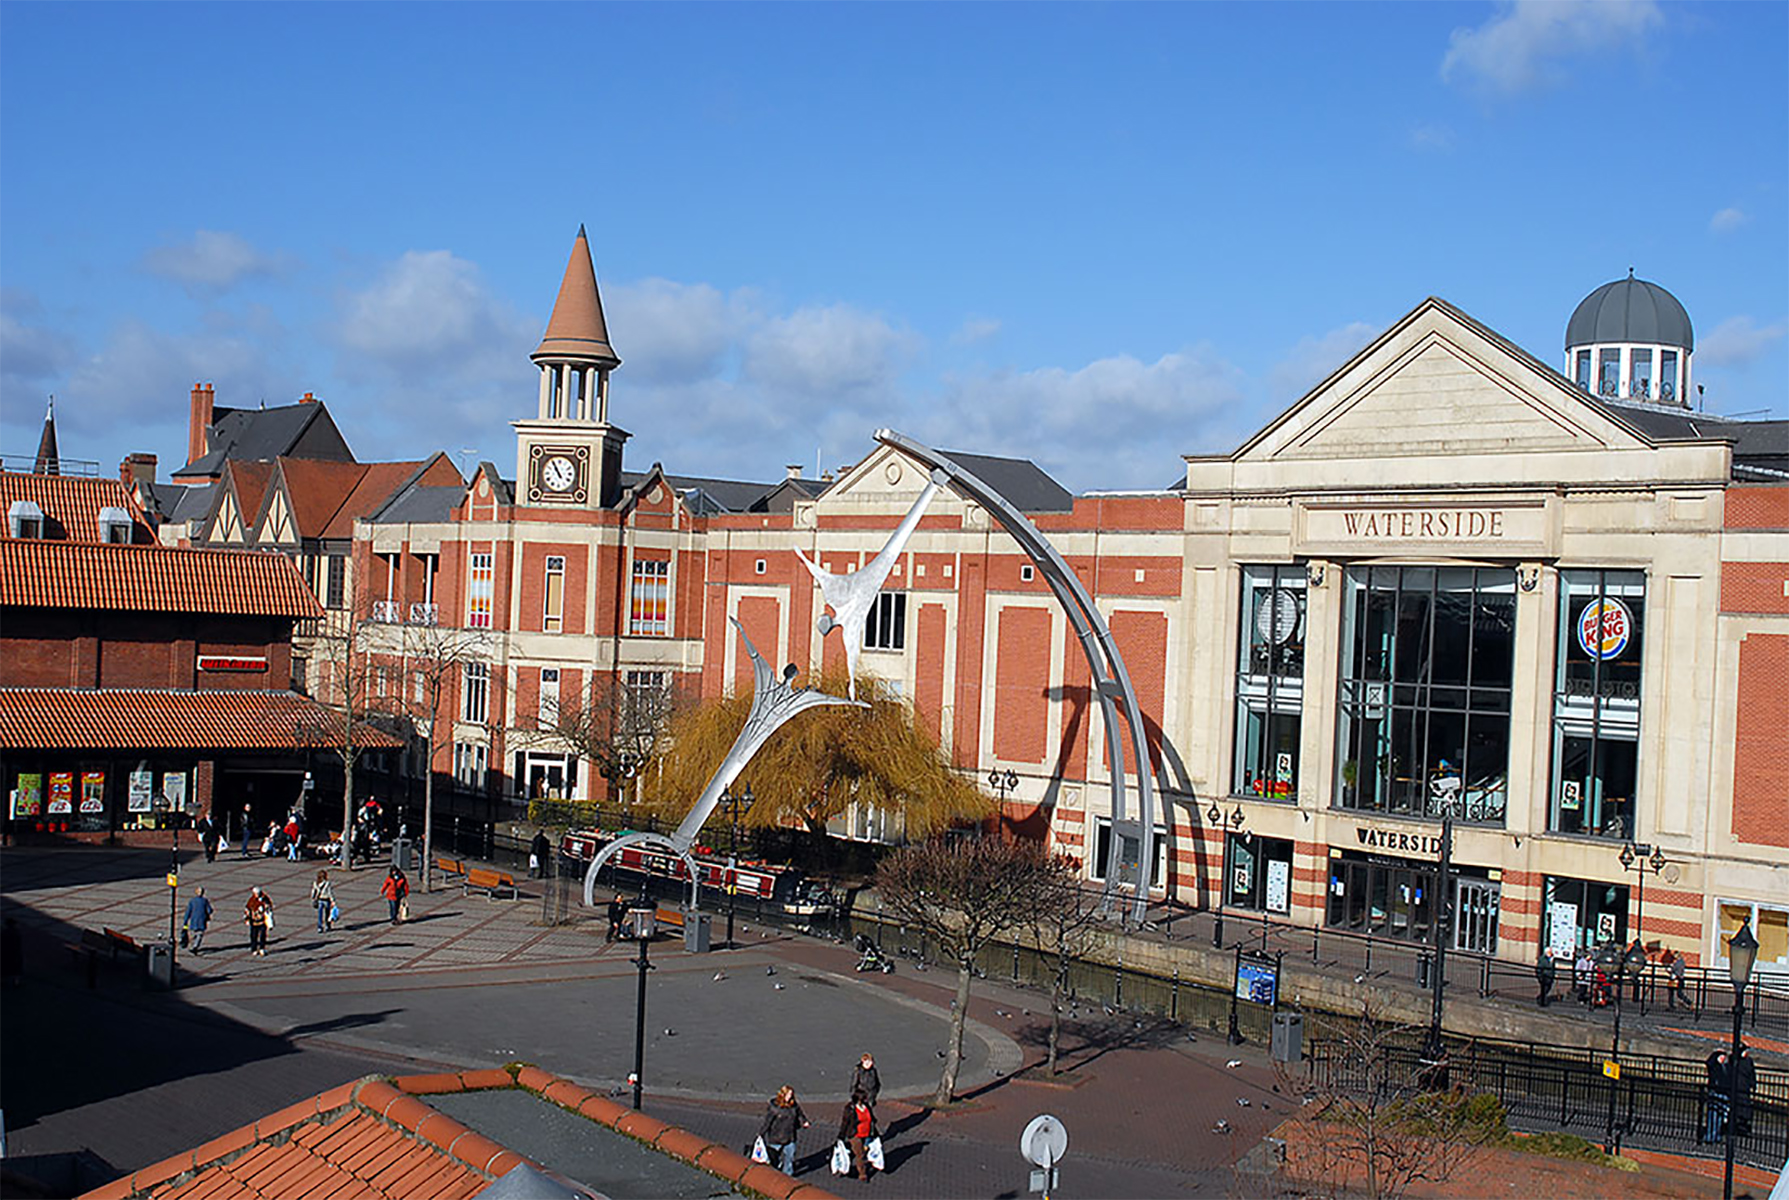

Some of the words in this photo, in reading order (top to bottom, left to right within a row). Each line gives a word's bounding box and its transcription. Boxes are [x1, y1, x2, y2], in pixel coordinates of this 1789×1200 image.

[1344, 511, 1503, 537] WATERSIDE
[1584, 610, 1622, 632] BUGER
[1585, 620, 1624, 646] KNG
